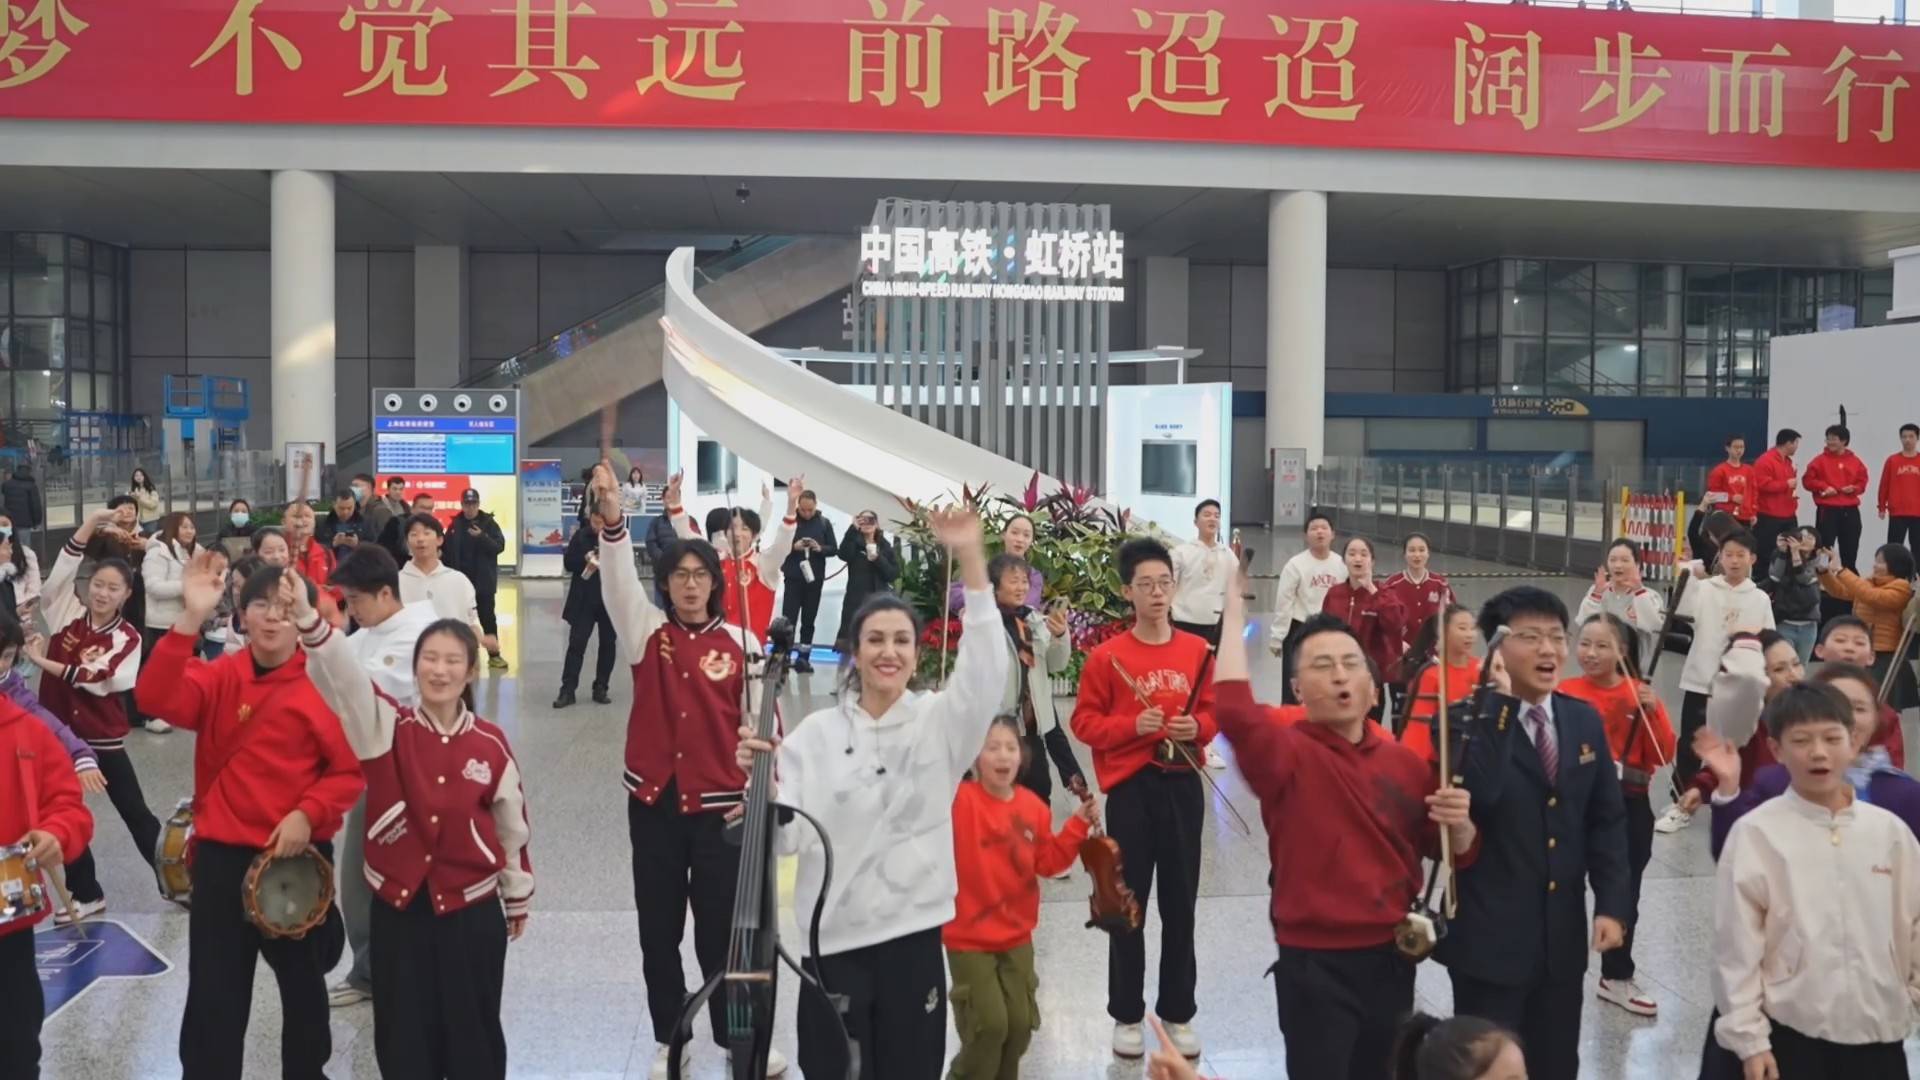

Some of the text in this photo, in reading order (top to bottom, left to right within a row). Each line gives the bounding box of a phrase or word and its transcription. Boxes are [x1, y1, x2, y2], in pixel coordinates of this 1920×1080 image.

[190, 0, 746, 101] 不觉其远
[843, 0, 1364, 121] 前路迢迢
[1452, 21, 1911, 143] 阔步而行
[861, 281, 892, 297] CHINA
[951, 283, 992, 299] RAILWAY
[1043, 285, 1084, 301] RAILWAY
[1085, 286, 1125, 302] STATION
